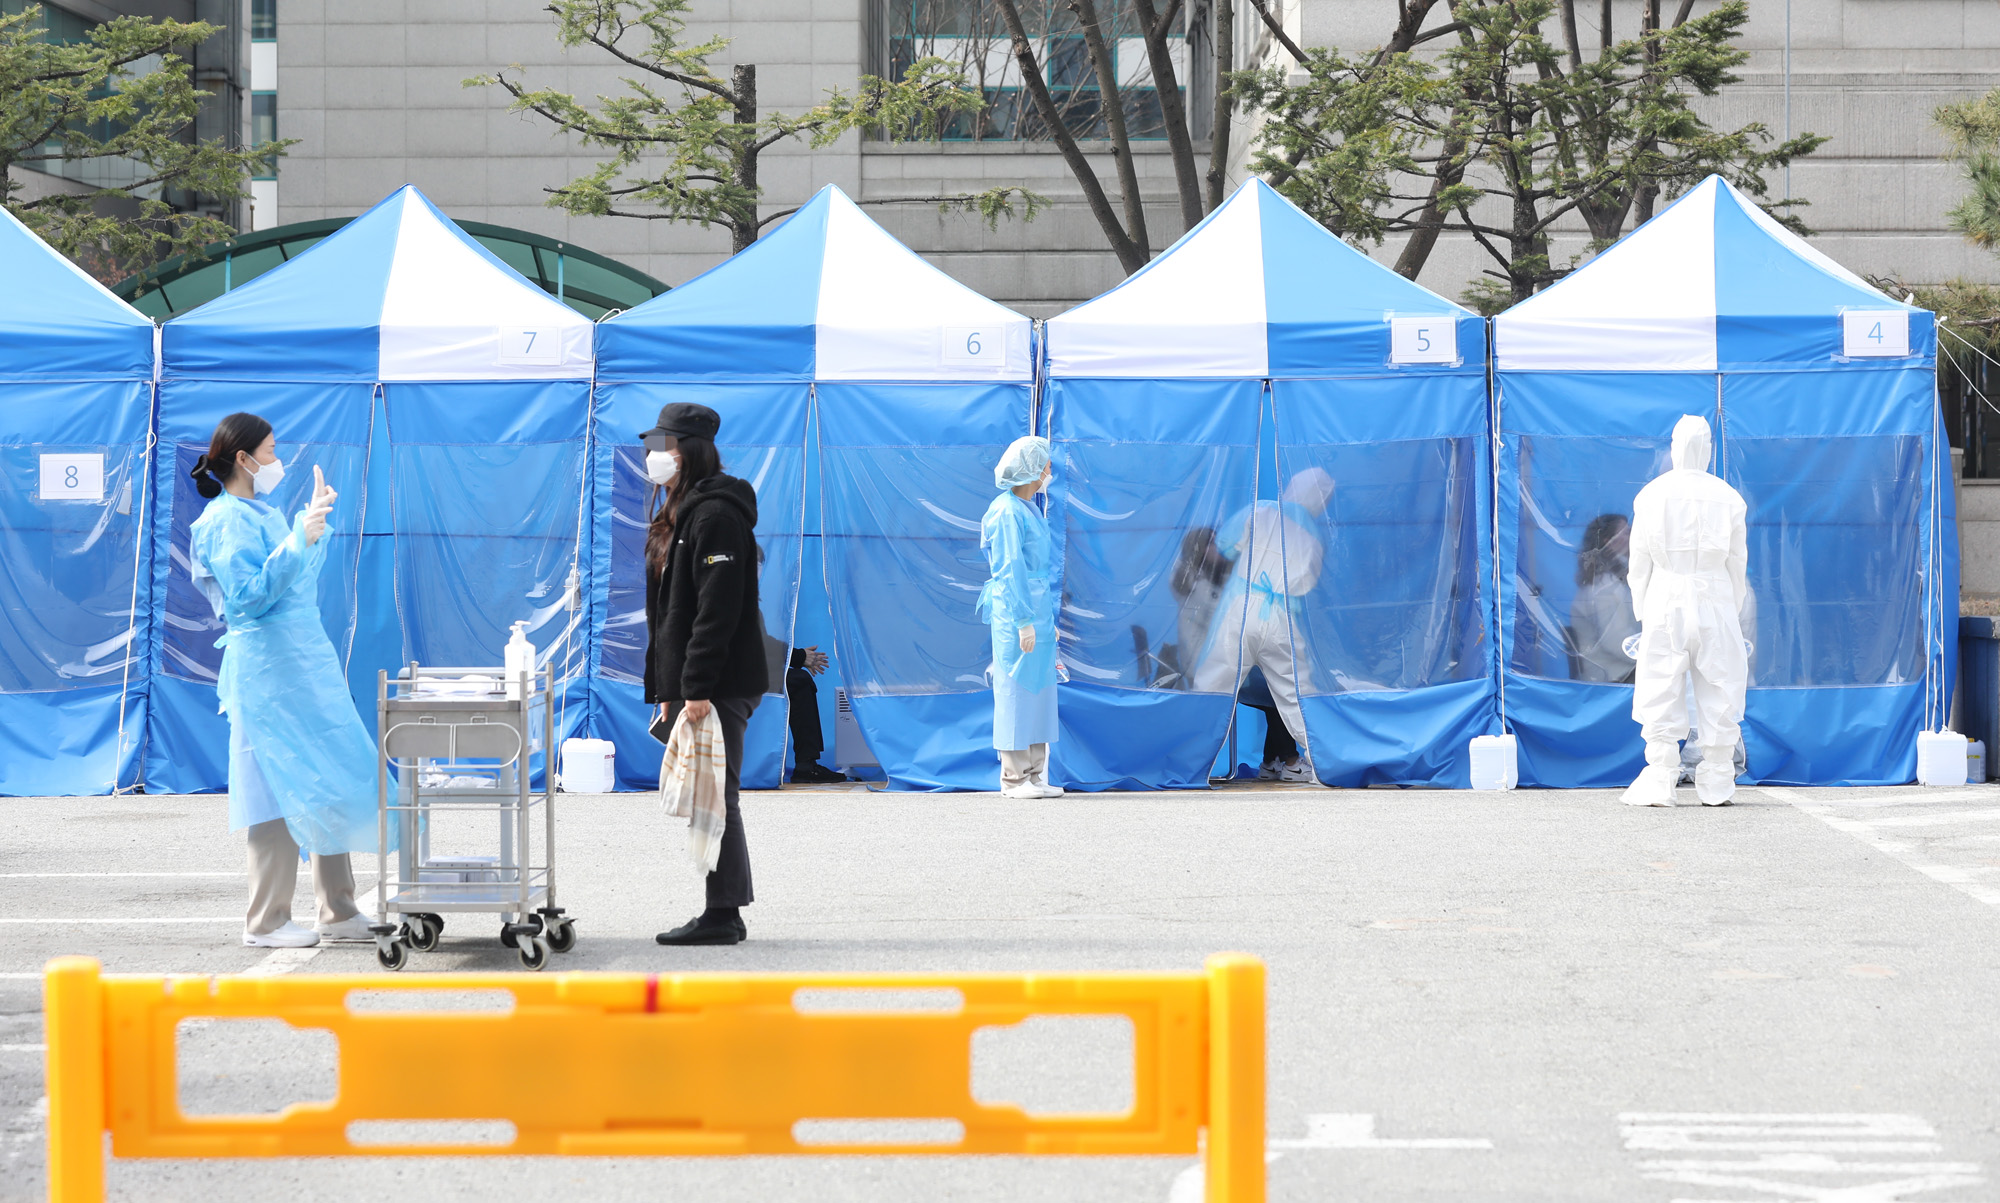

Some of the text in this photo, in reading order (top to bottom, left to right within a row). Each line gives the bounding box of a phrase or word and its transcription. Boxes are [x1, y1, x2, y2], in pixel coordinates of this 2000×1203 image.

[522, 332, 537, 354] 7
[967, 332, 981, 355] 6
[1417, 329, 1430, 351] 5
[1867, 322, 1883, 344] 4
[64, 465, 78, 488] 8
